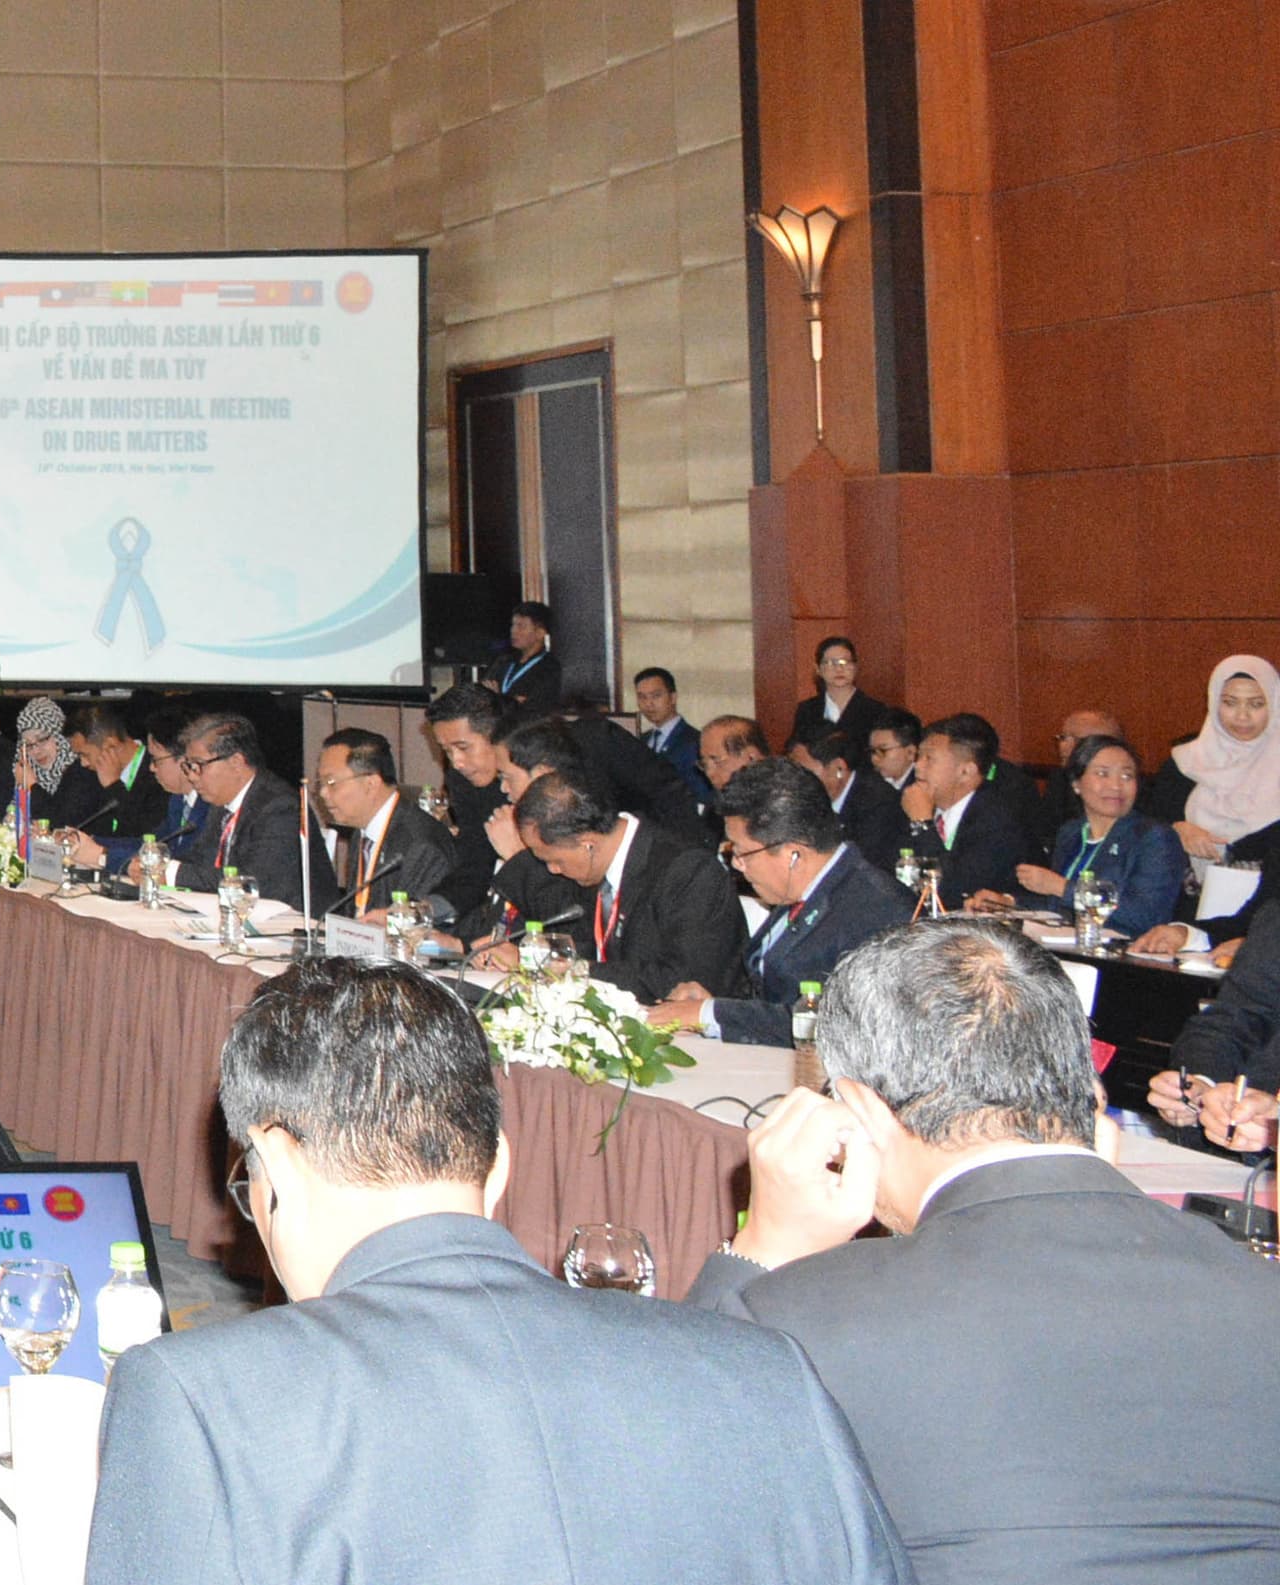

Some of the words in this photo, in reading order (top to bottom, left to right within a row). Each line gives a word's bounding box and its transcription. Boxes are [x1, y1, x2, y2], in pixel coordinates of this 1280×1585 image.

[162, 325, 224, 347] ASEAN
[140, 357, 169, 380] MA
[24, 397, 84, 420] ASEAN
[89, 396, 205, 420] MINISTERIAL
[209, 396, 292, 420] MEETING
[42, 430, 68, 452] ON
[72, 430, 121, 452] DRUG
[126, 429, 208, 452] MATTERS
[19, 1231, 33, 1250] 6
